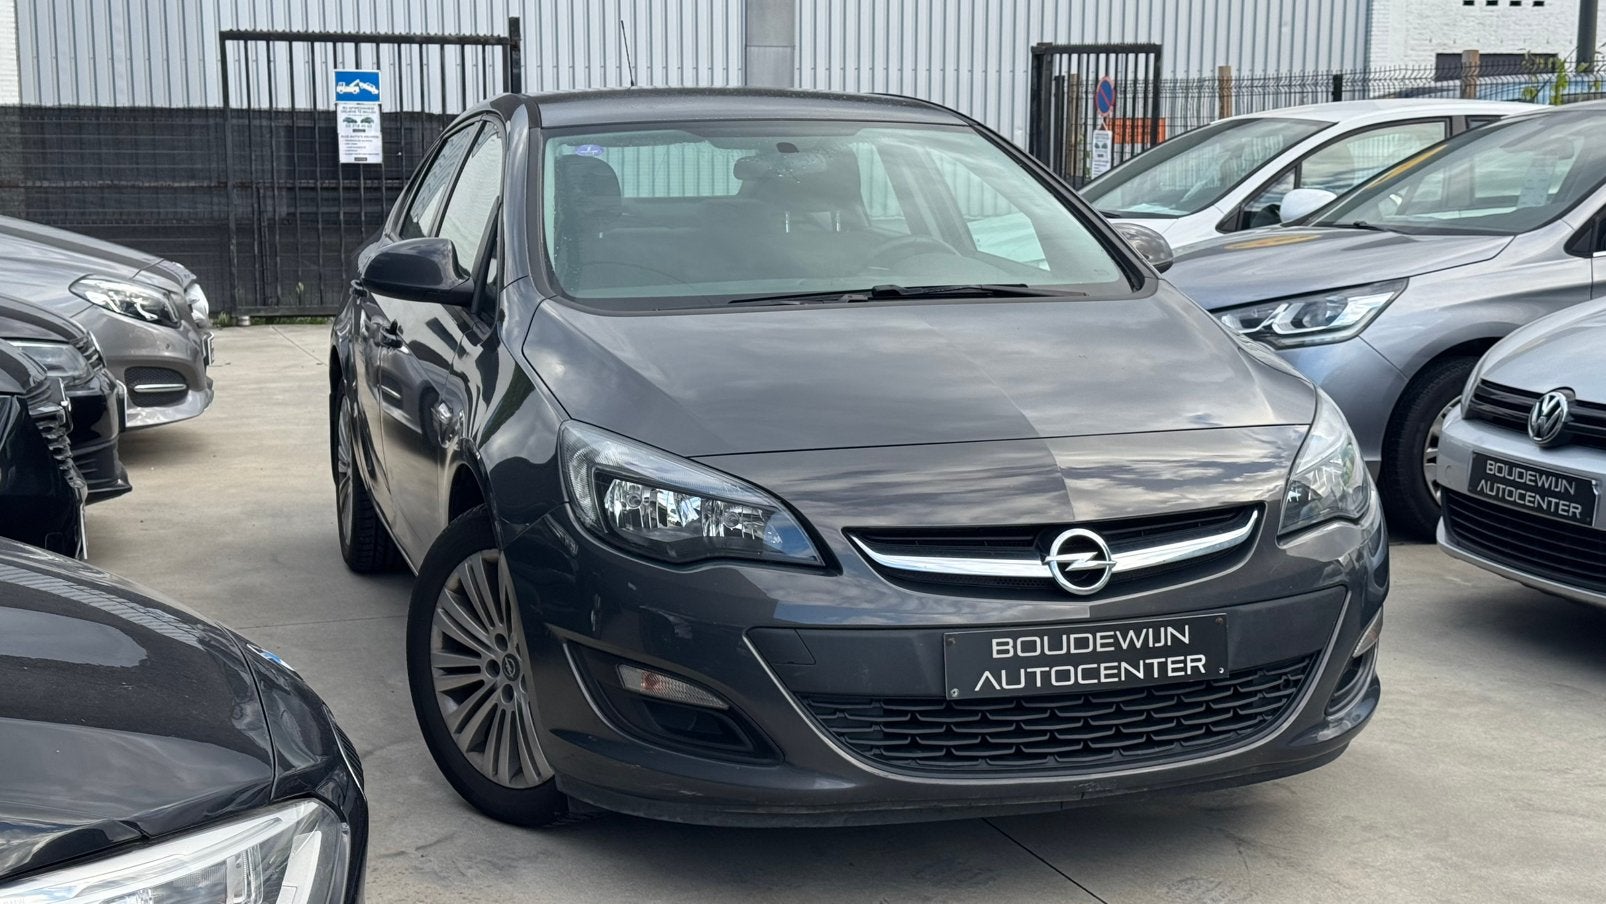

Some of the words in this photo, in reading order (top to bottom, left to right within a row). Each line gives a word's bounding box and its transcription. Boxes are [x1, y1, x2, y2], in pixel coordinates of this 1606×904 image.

[1486, 460, 1575, 495] BOUDEWIJN
[1477, 479, 1582, 518] AUTOCENTER
[992, 624, 1190, 659] BOUDEWIJN
[974, 654, 1206, 691] AUTOCENTER
